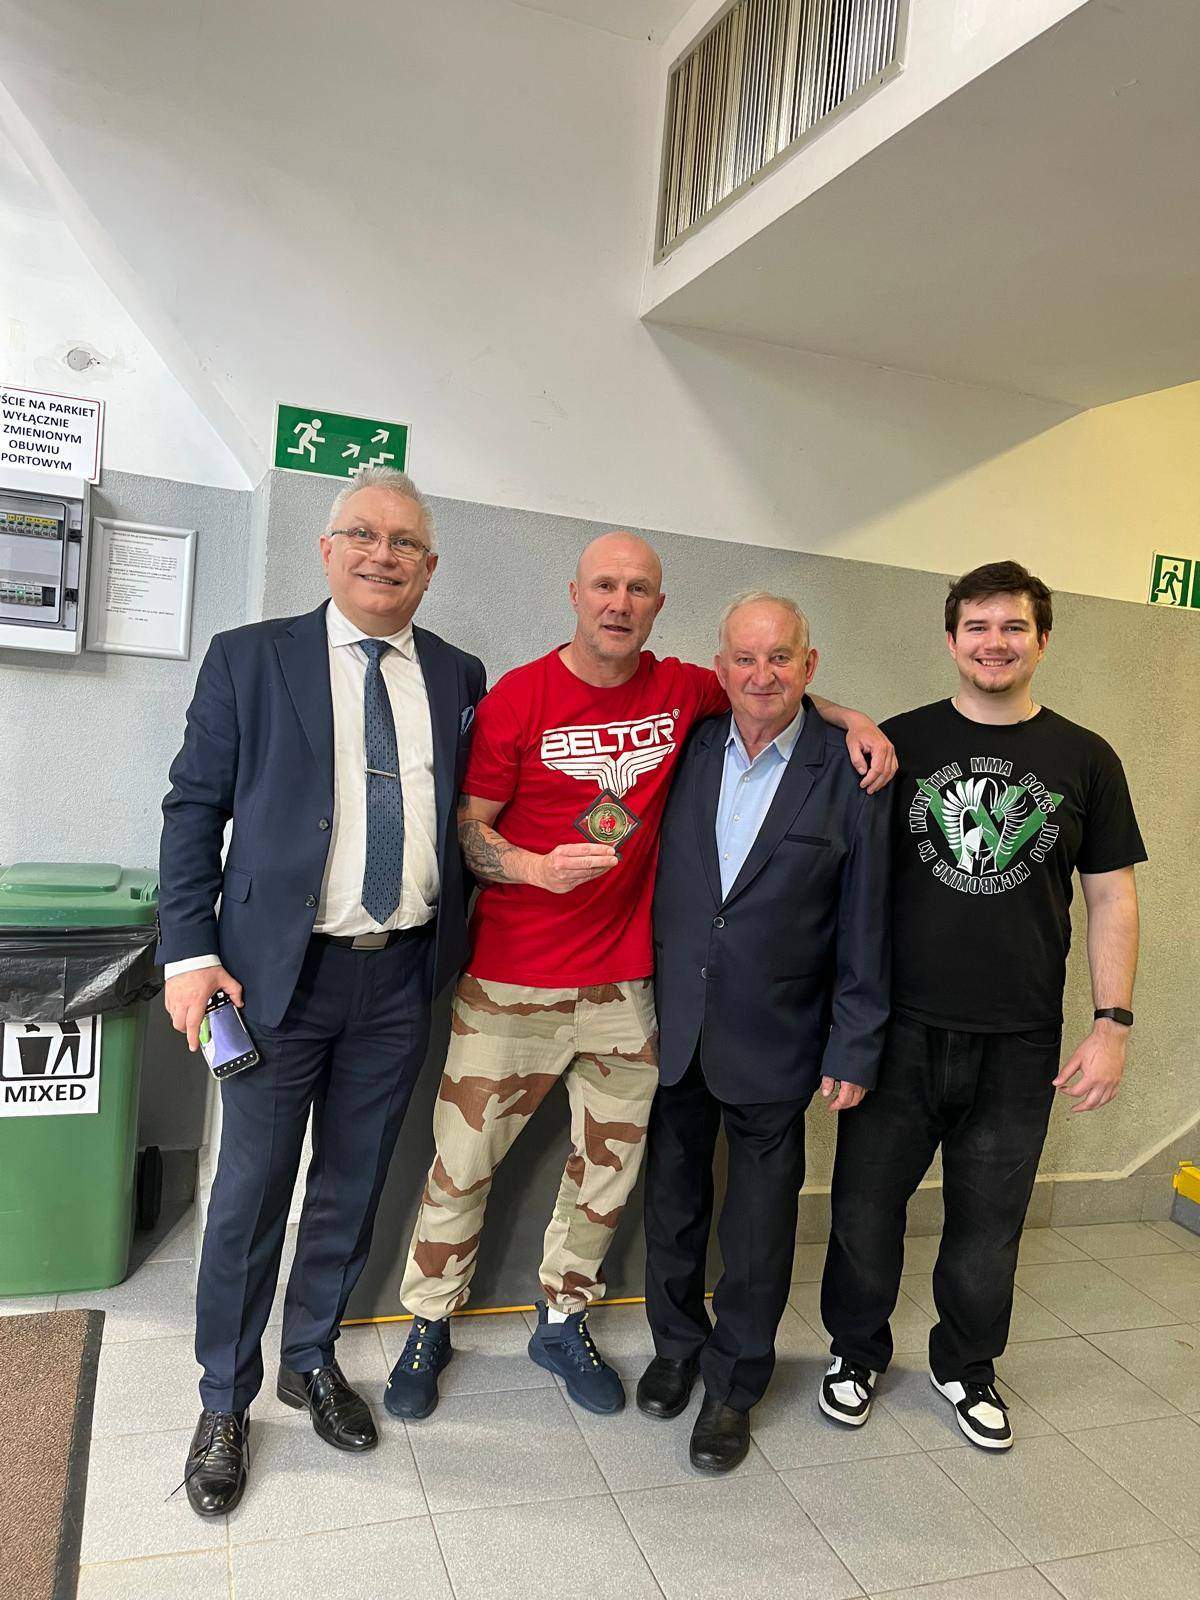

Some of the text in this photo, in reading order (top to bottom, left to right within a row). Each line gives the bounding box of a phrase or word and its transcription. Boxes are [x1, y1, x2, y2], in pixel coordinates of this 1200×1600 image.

[0, 393, 96, 418] ŚCIE NA PARKIET
[3, 409, 70, 428] WYŁĄCZNIE
[3, 424, 82, 444] ZMIENIONYM
[9, 439, 60, 455] OBUWIU
[541, 717, 675, 760] BELTOR
[909, 757, 1060, 895] MUAY THAI MMA BOKS JUDO KICKBOXING K1
[4, 1083, 87, 1103] MIXED
